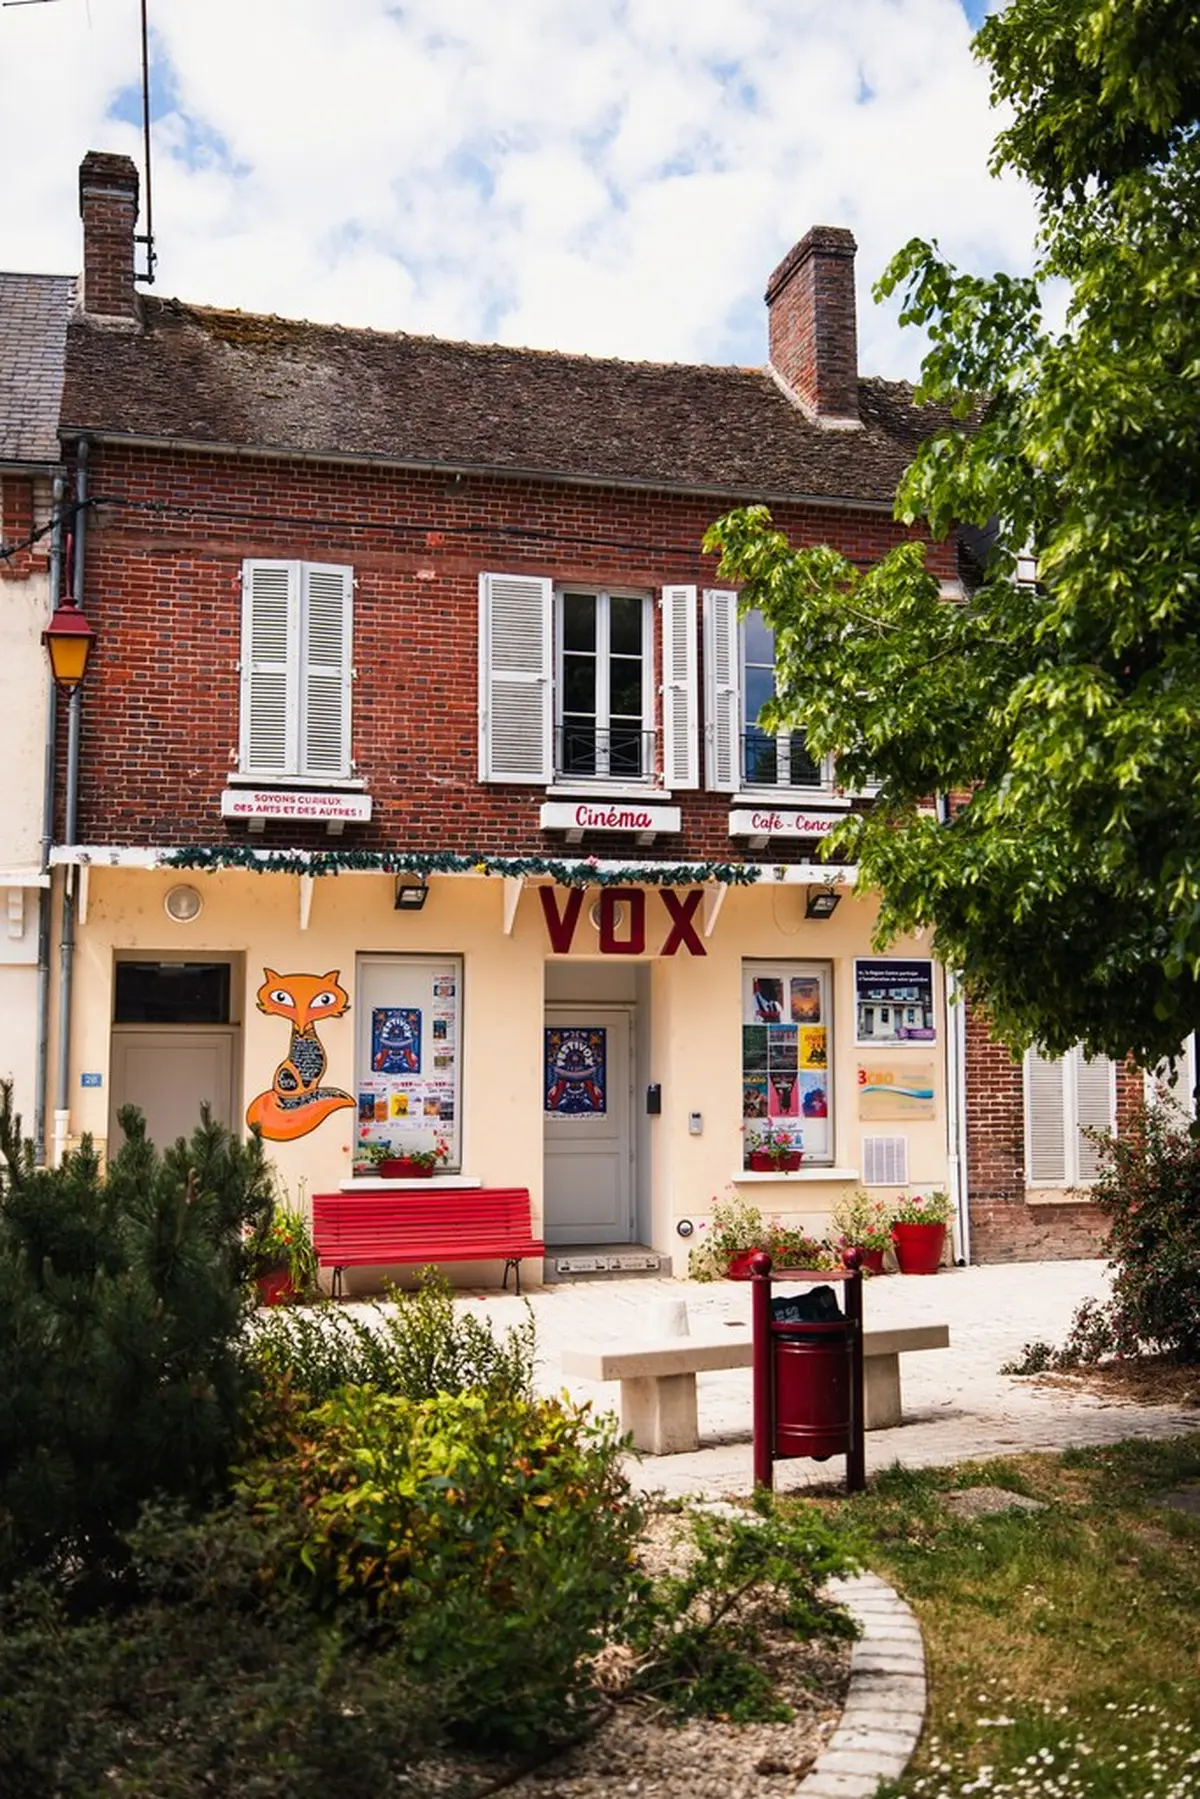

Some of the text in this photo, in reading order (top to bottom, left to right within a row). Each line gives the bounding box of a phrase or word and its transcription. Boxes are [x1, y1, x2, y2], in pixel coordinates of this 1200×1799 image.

[233, 803, 253, 812] DES
[256, 804, 281, 814] ARTS
[283, 805, 296, 815] ET
[297, 806, 316, 816] DES
[319, 807, 357, 817] AUTRES
[254, 794, 342, 806] SOYONS CURIEUX
[575, 805, 652, 828] Cinéma
[752, 813, 784, 832] Café
[538, 885, 708, 956] VOX
[381, 1018, 413, 1039] FESTIVOX
[556, 1041, 595, 1067] FESTIVOX
